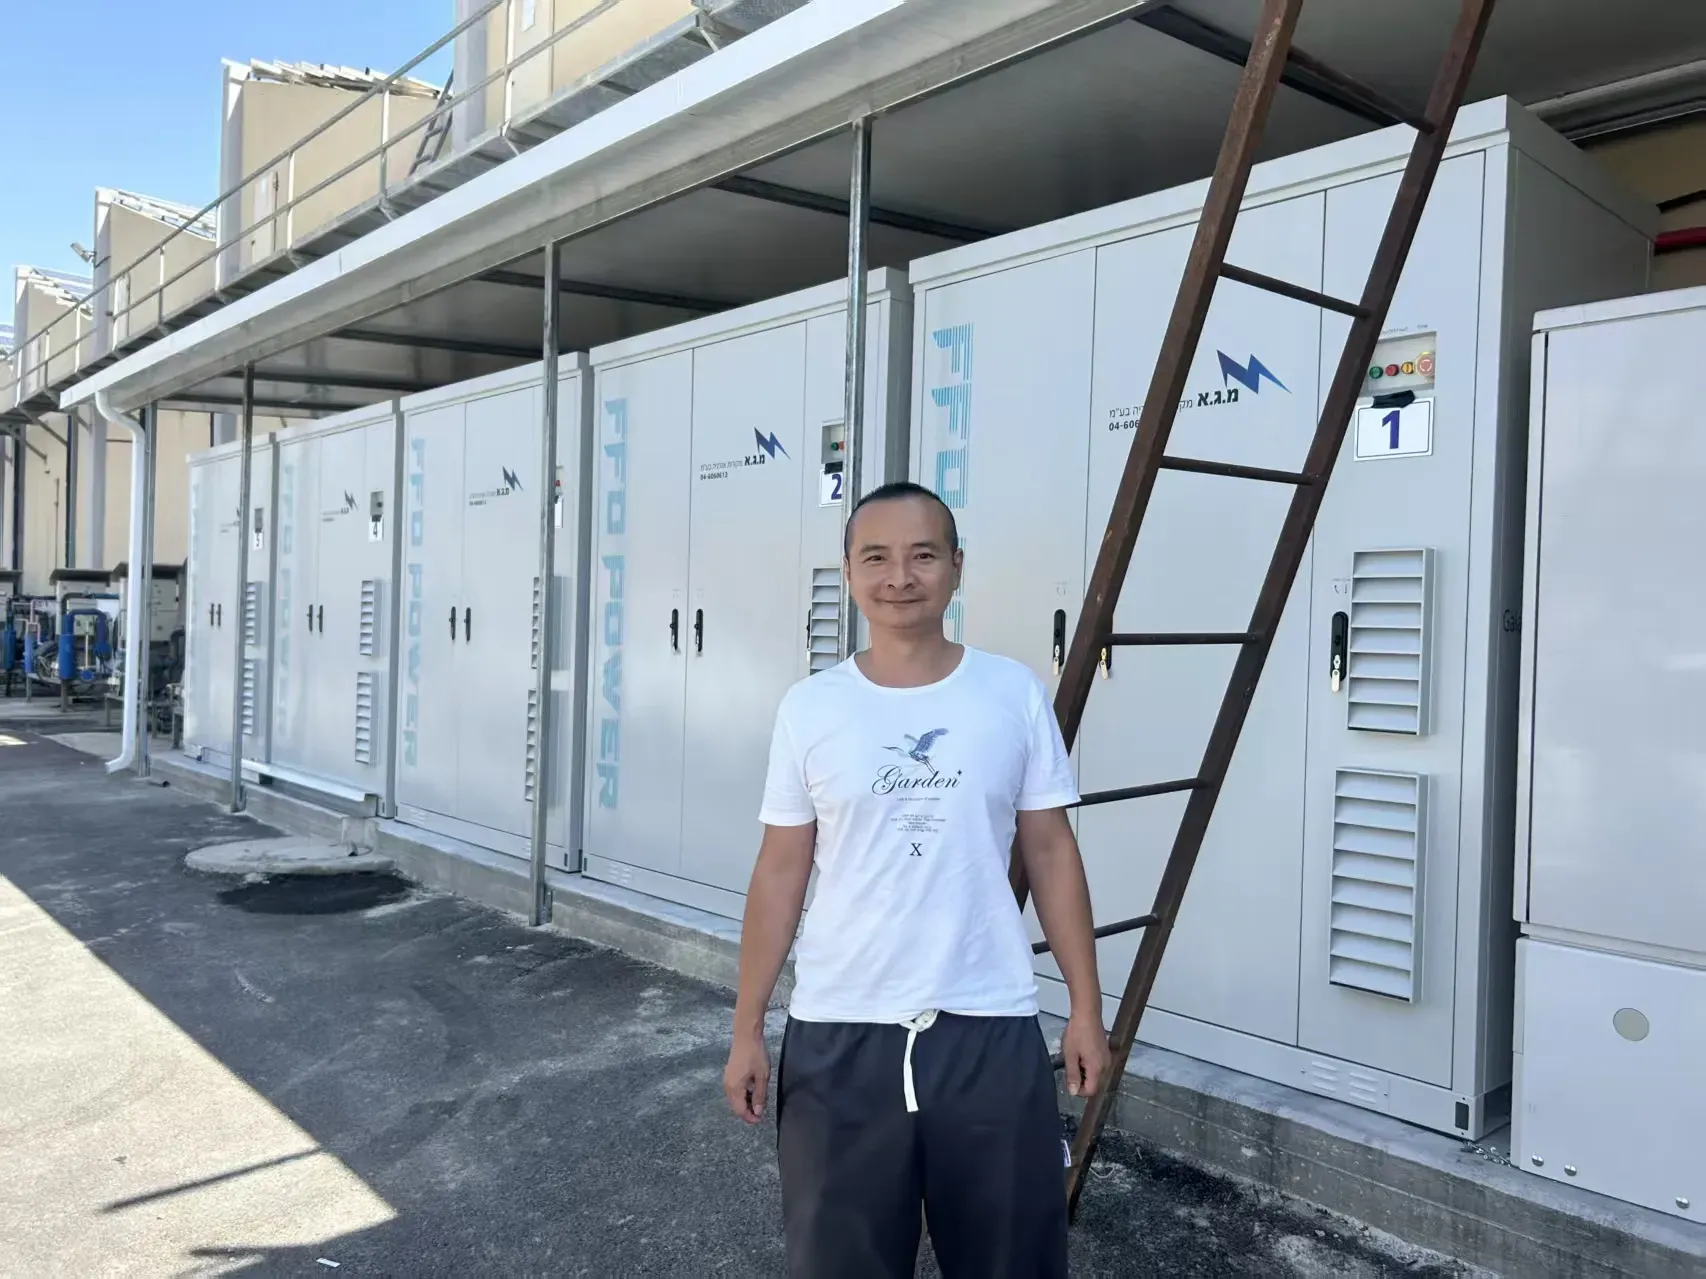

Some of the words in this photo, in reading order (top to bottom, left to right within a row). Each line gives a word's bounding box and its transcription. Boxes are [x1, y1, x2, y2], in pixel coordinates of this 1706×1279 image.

[1197, 388, 1239, 407] מ.ג.א
[1109, 420, 1140, 431] 04-606
[1382, 410, 1400, 449] 1
[831, 474, 842, 500] 2
[596, 554, 626, 810] POWER
[872, 764, 960, 795] Garden
[909, 843, 922, 857] X
